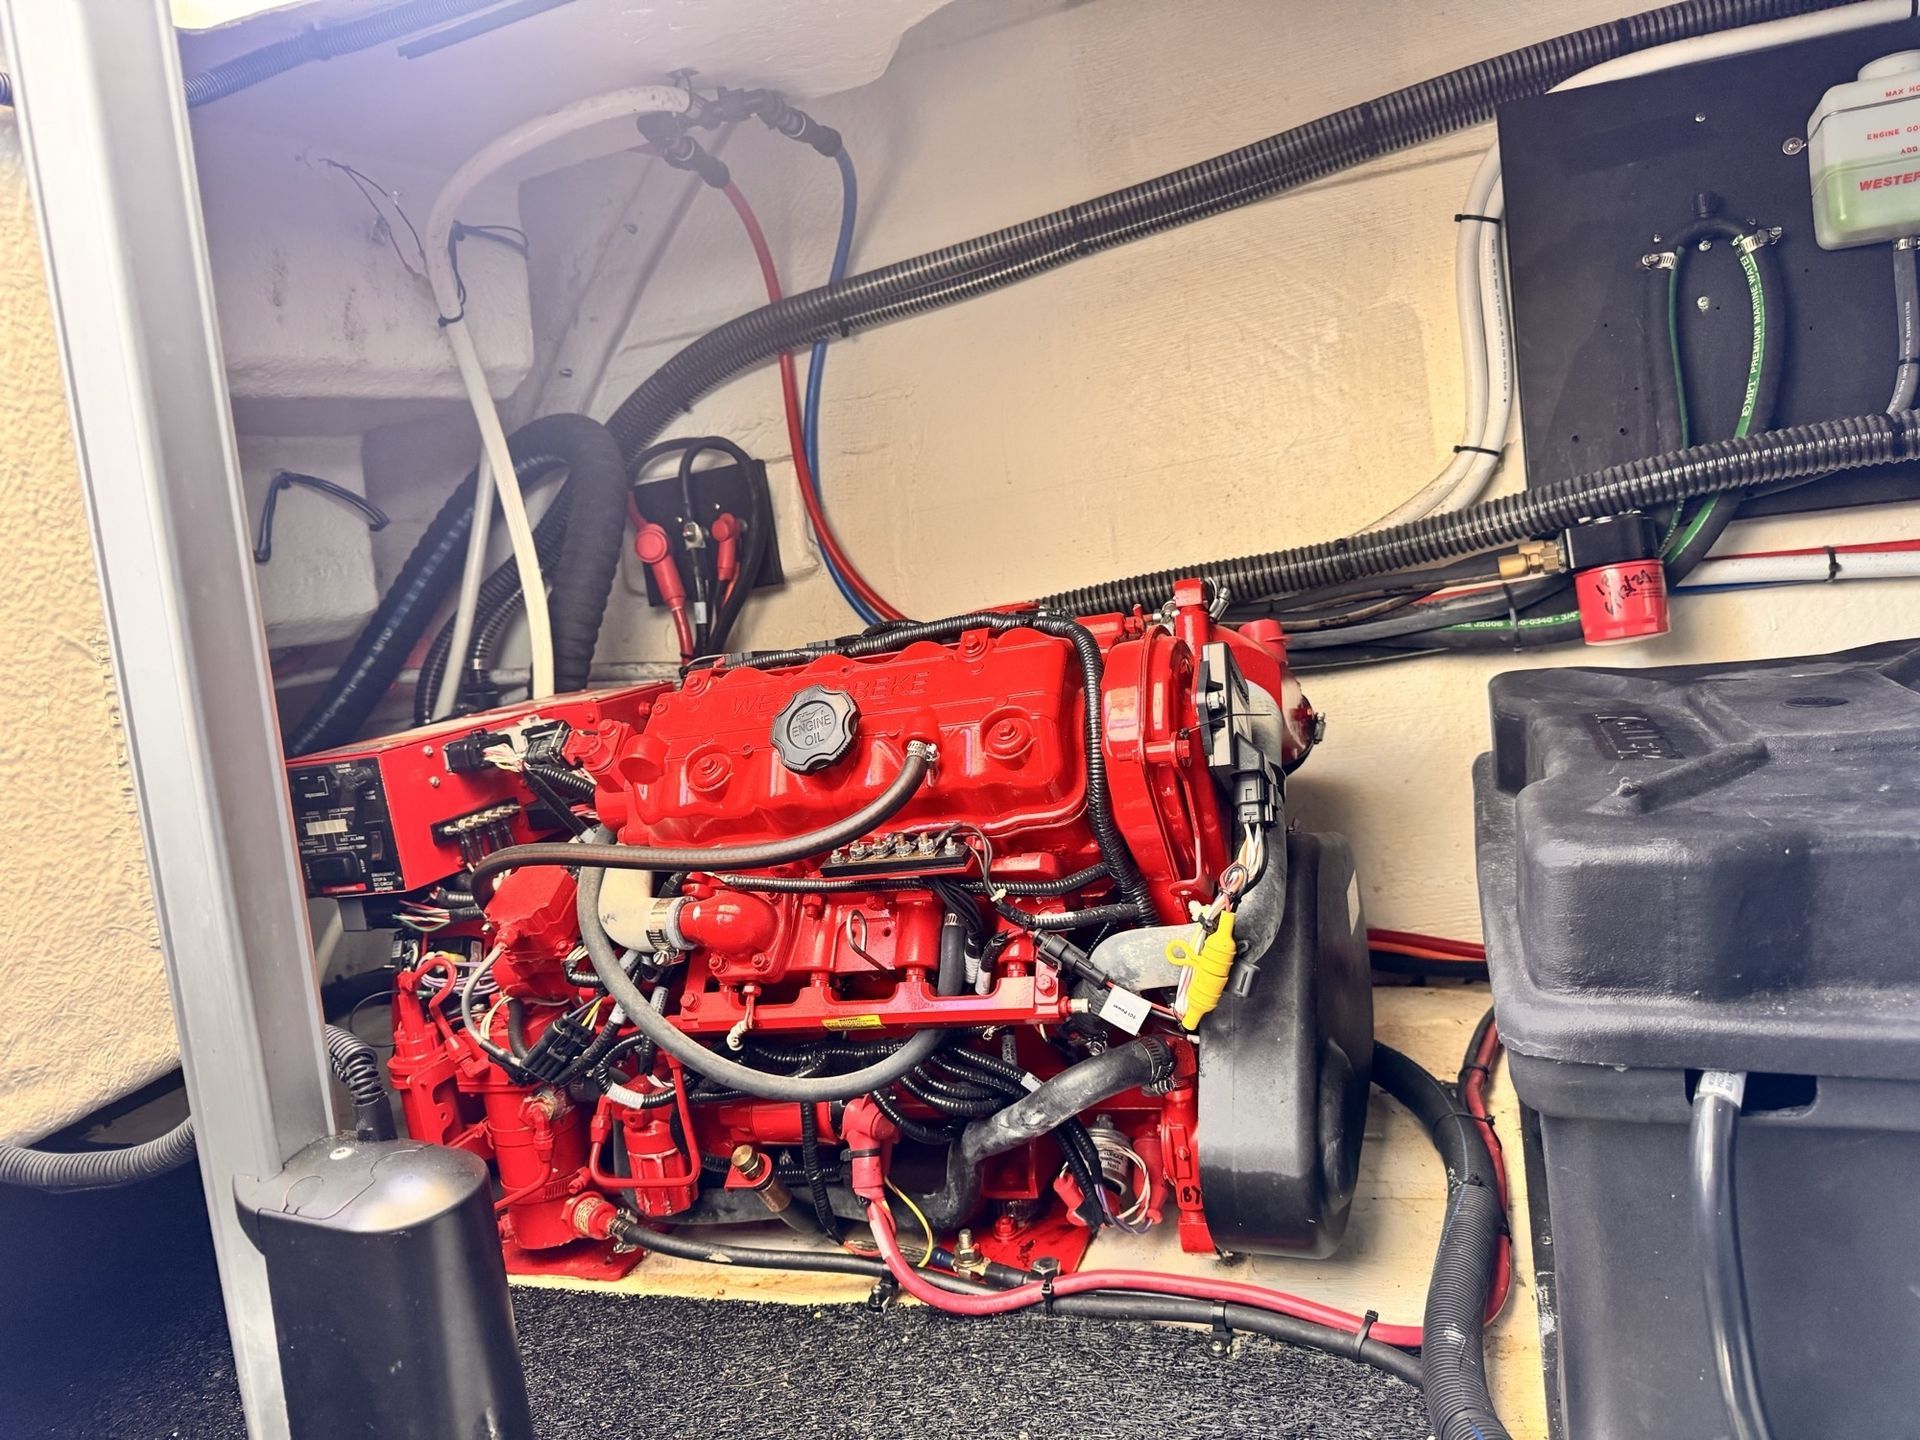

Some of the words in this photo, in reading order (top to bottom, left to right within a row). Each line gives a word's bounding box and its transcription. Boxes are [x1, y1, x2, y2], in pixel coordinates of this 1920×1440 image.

[1885, 88, 1904, 97] MAX
[1866, 129, 1900, 141] ENGINE
[1901, 146, 1918, 155] ADD
[1752, 289, 1763, 328] MARINE
[1750, 329, 1762, 374] PREMIUM
[791, 713, 832, 739] ENGINE
[804, 731, 825, 746] OIL
